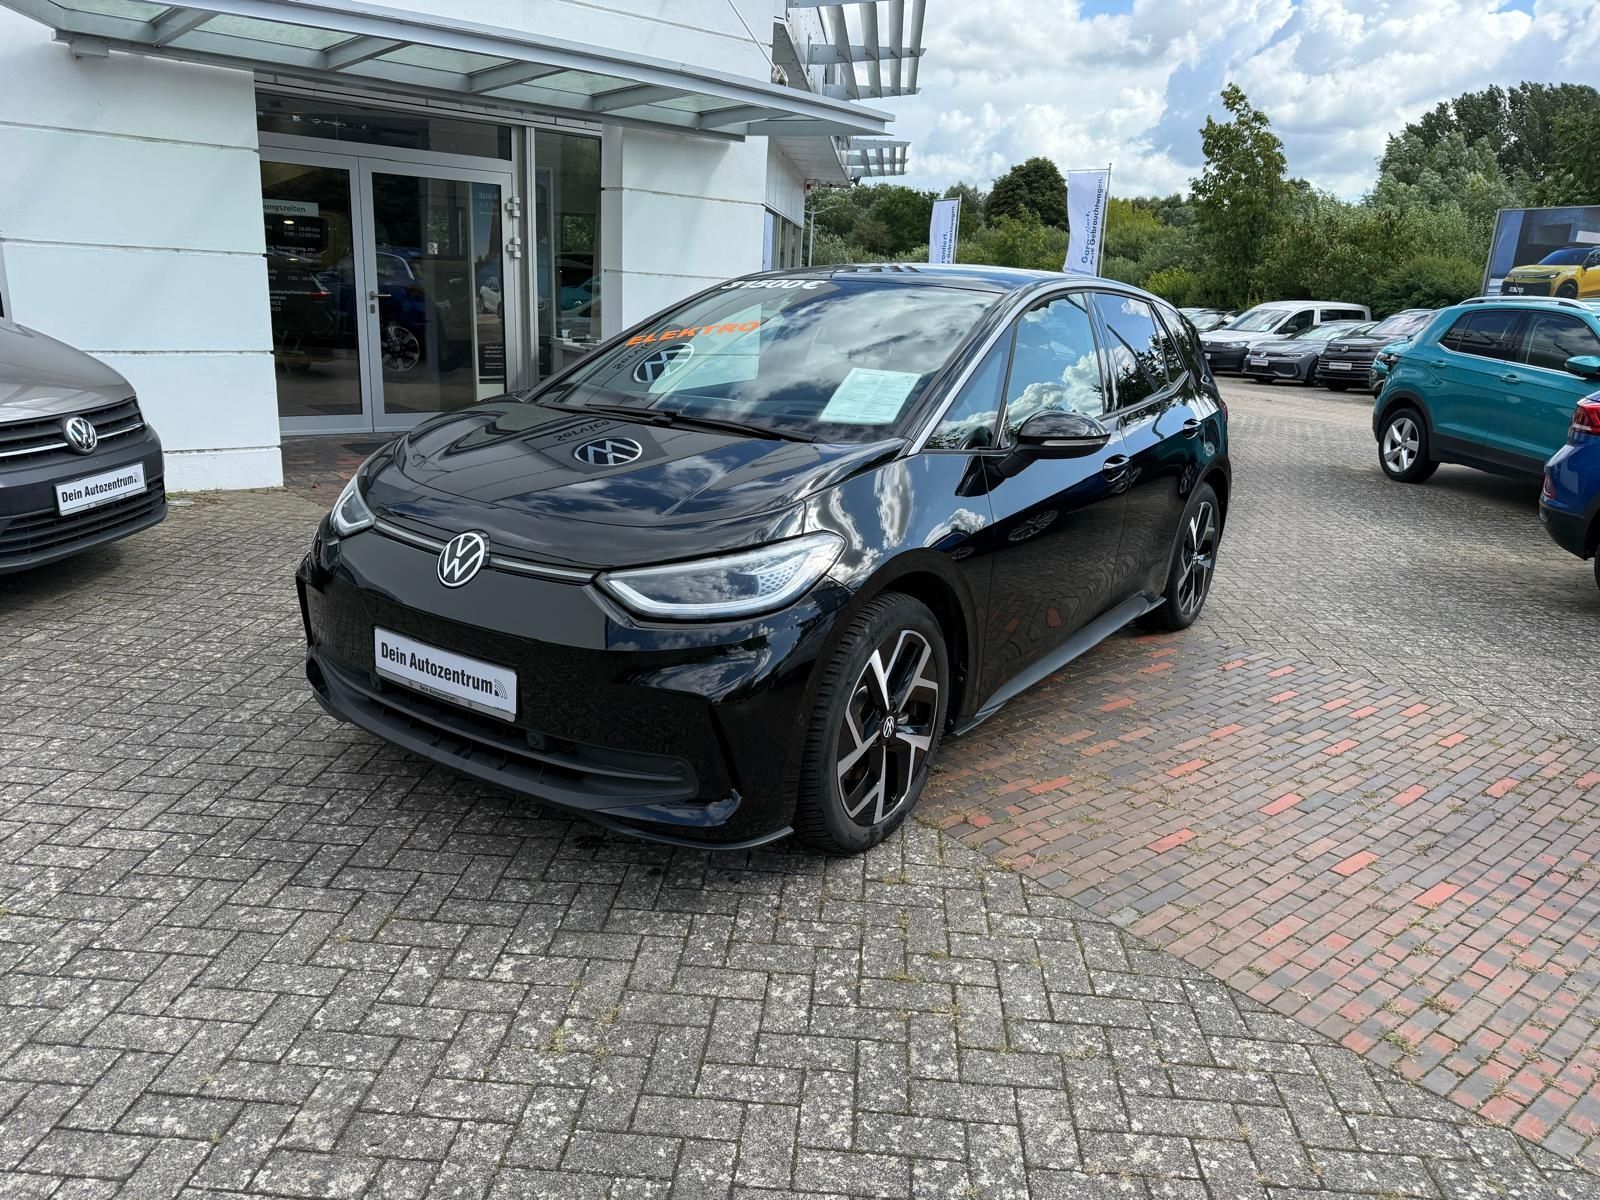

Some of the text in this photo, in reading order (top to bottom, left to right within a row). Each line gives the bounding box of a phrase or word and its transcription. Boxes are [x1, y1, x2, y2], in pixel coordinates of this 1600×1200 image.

[263, 204, 306, 213] ungszeiten
[624, 320, 761, 347] ELEKTRO
[61, 490, 83, 503] Dein
[381, 641, 493, 695] Dein Autozentrum
